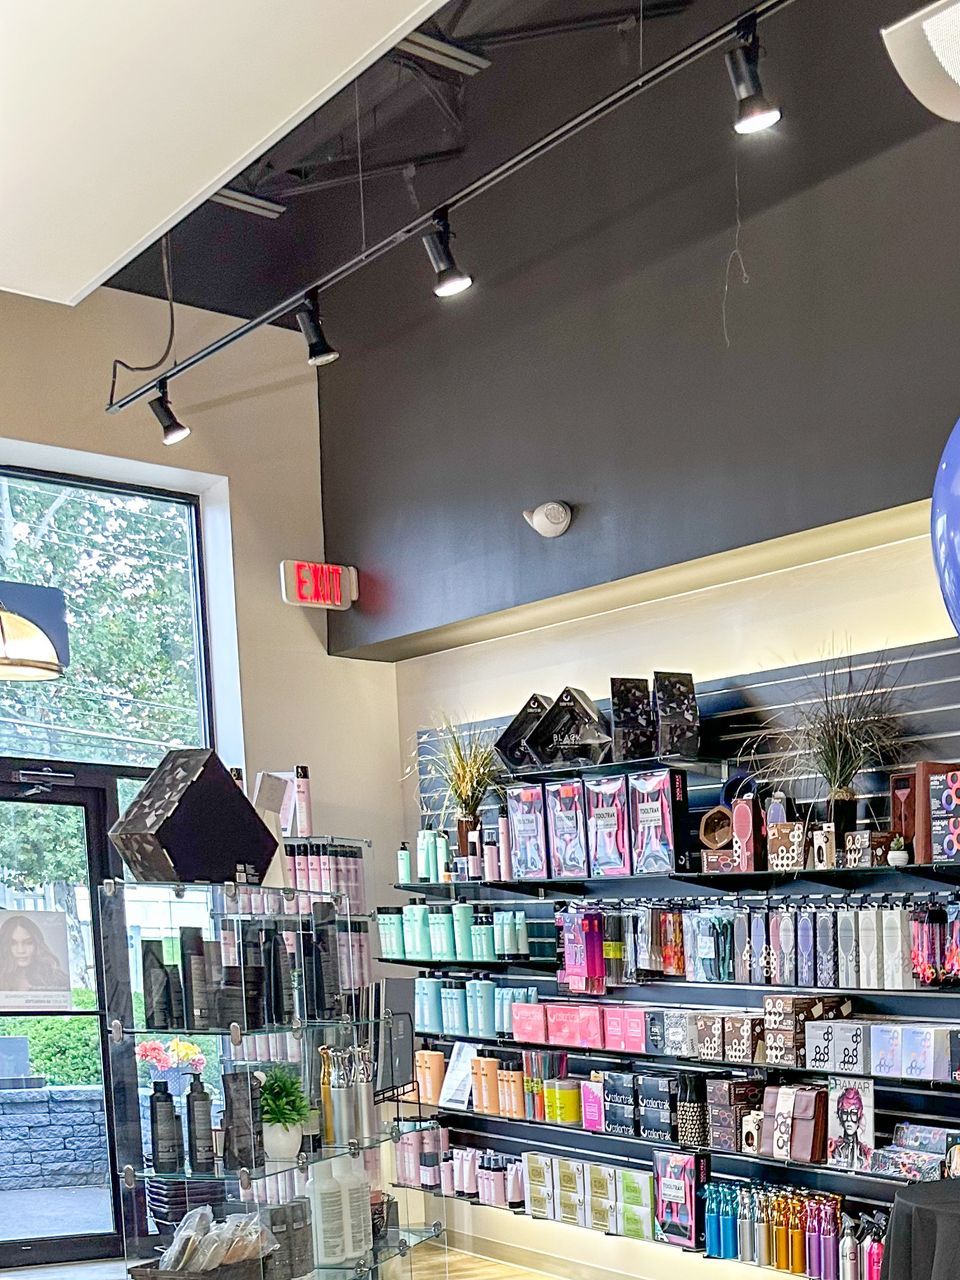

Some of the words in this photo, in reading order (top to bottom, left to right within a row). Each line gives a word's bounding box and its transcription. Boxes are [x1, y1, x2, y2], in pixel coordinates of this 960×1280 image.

[294, 561, 342, 606] EXIT
[611, 1092, 634, 1105] colortrak
[646, 1097, 670, 1110] colortrak
[612, 1123, 635, 1136] colortrak
[648, 1129, 672, 1141] colortrak
